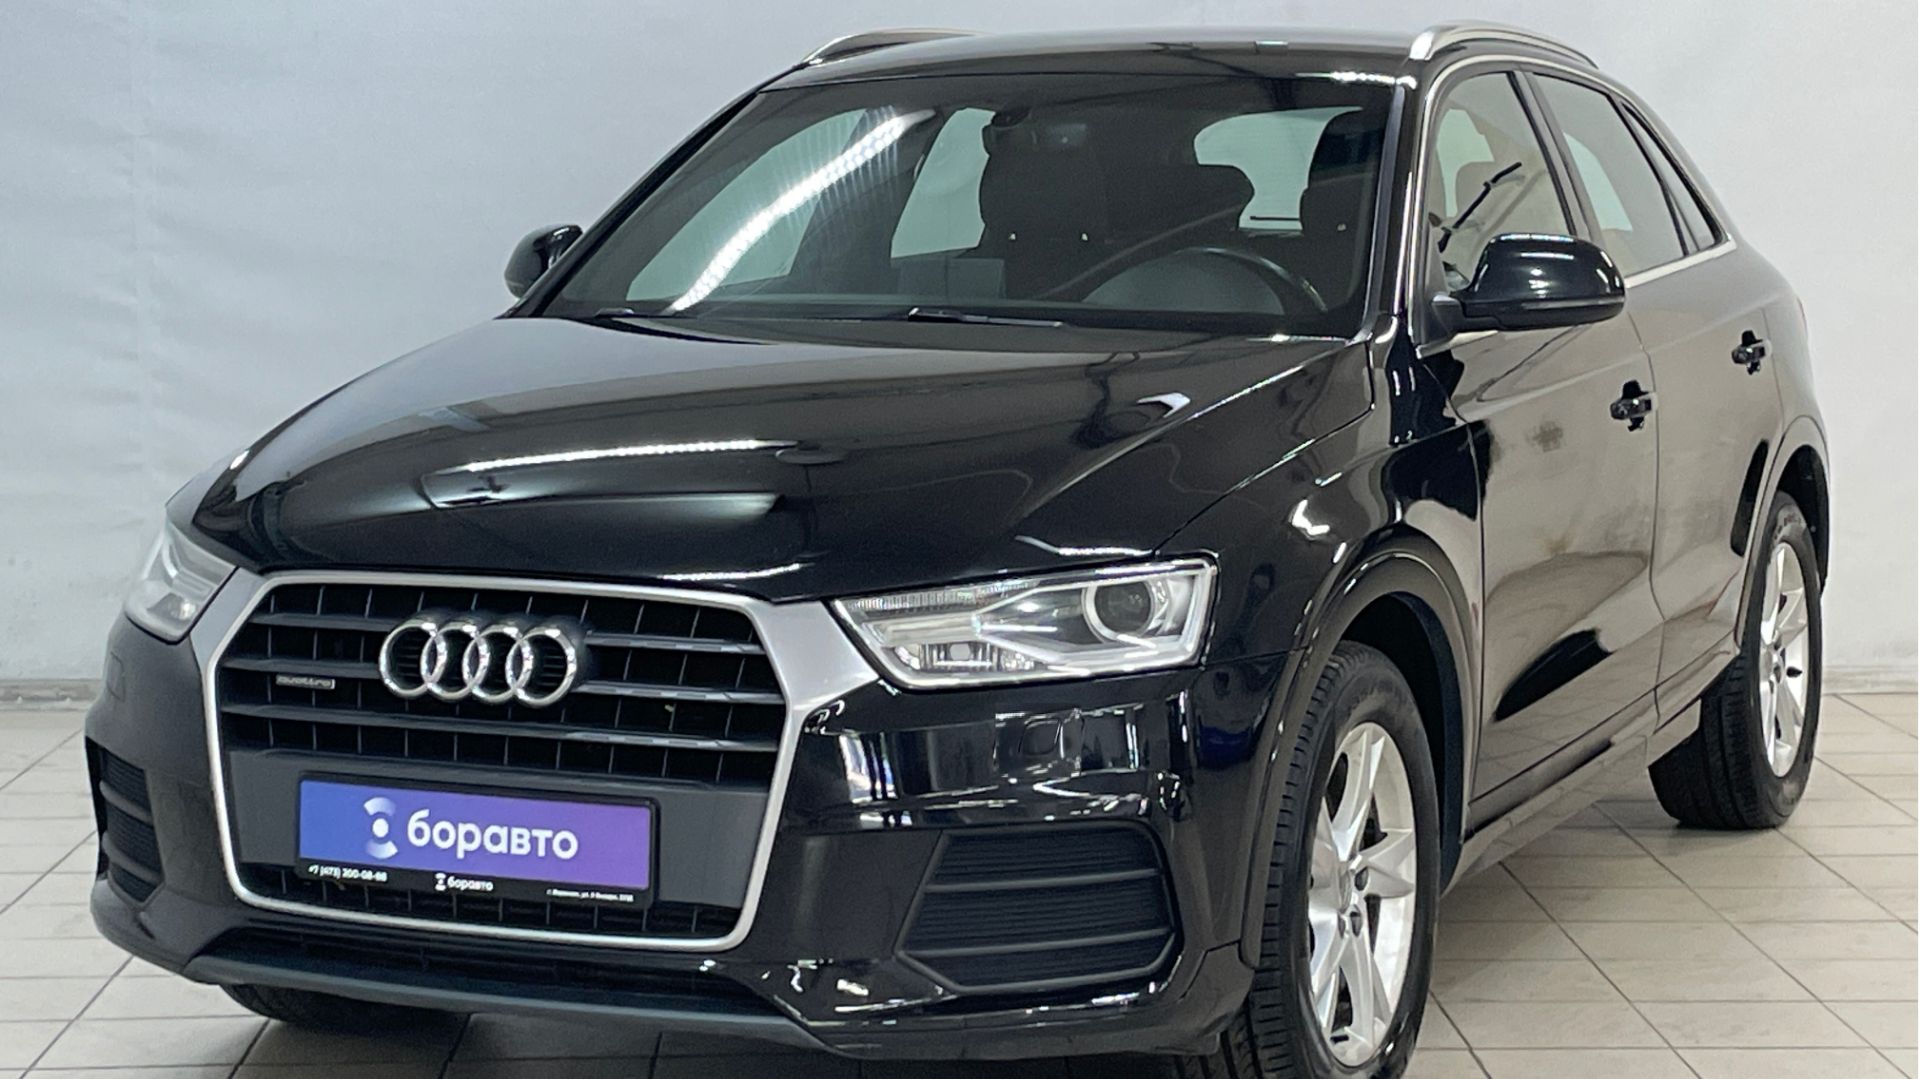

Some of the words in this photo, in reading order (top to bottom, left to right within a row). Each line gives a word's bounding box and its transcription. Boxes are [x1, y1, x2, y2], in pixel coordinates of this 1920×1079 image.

[276, 675, 332, 688] quattro
[407, 809, 579, 860] боравто
[447, 876, 494, 891] боравто
